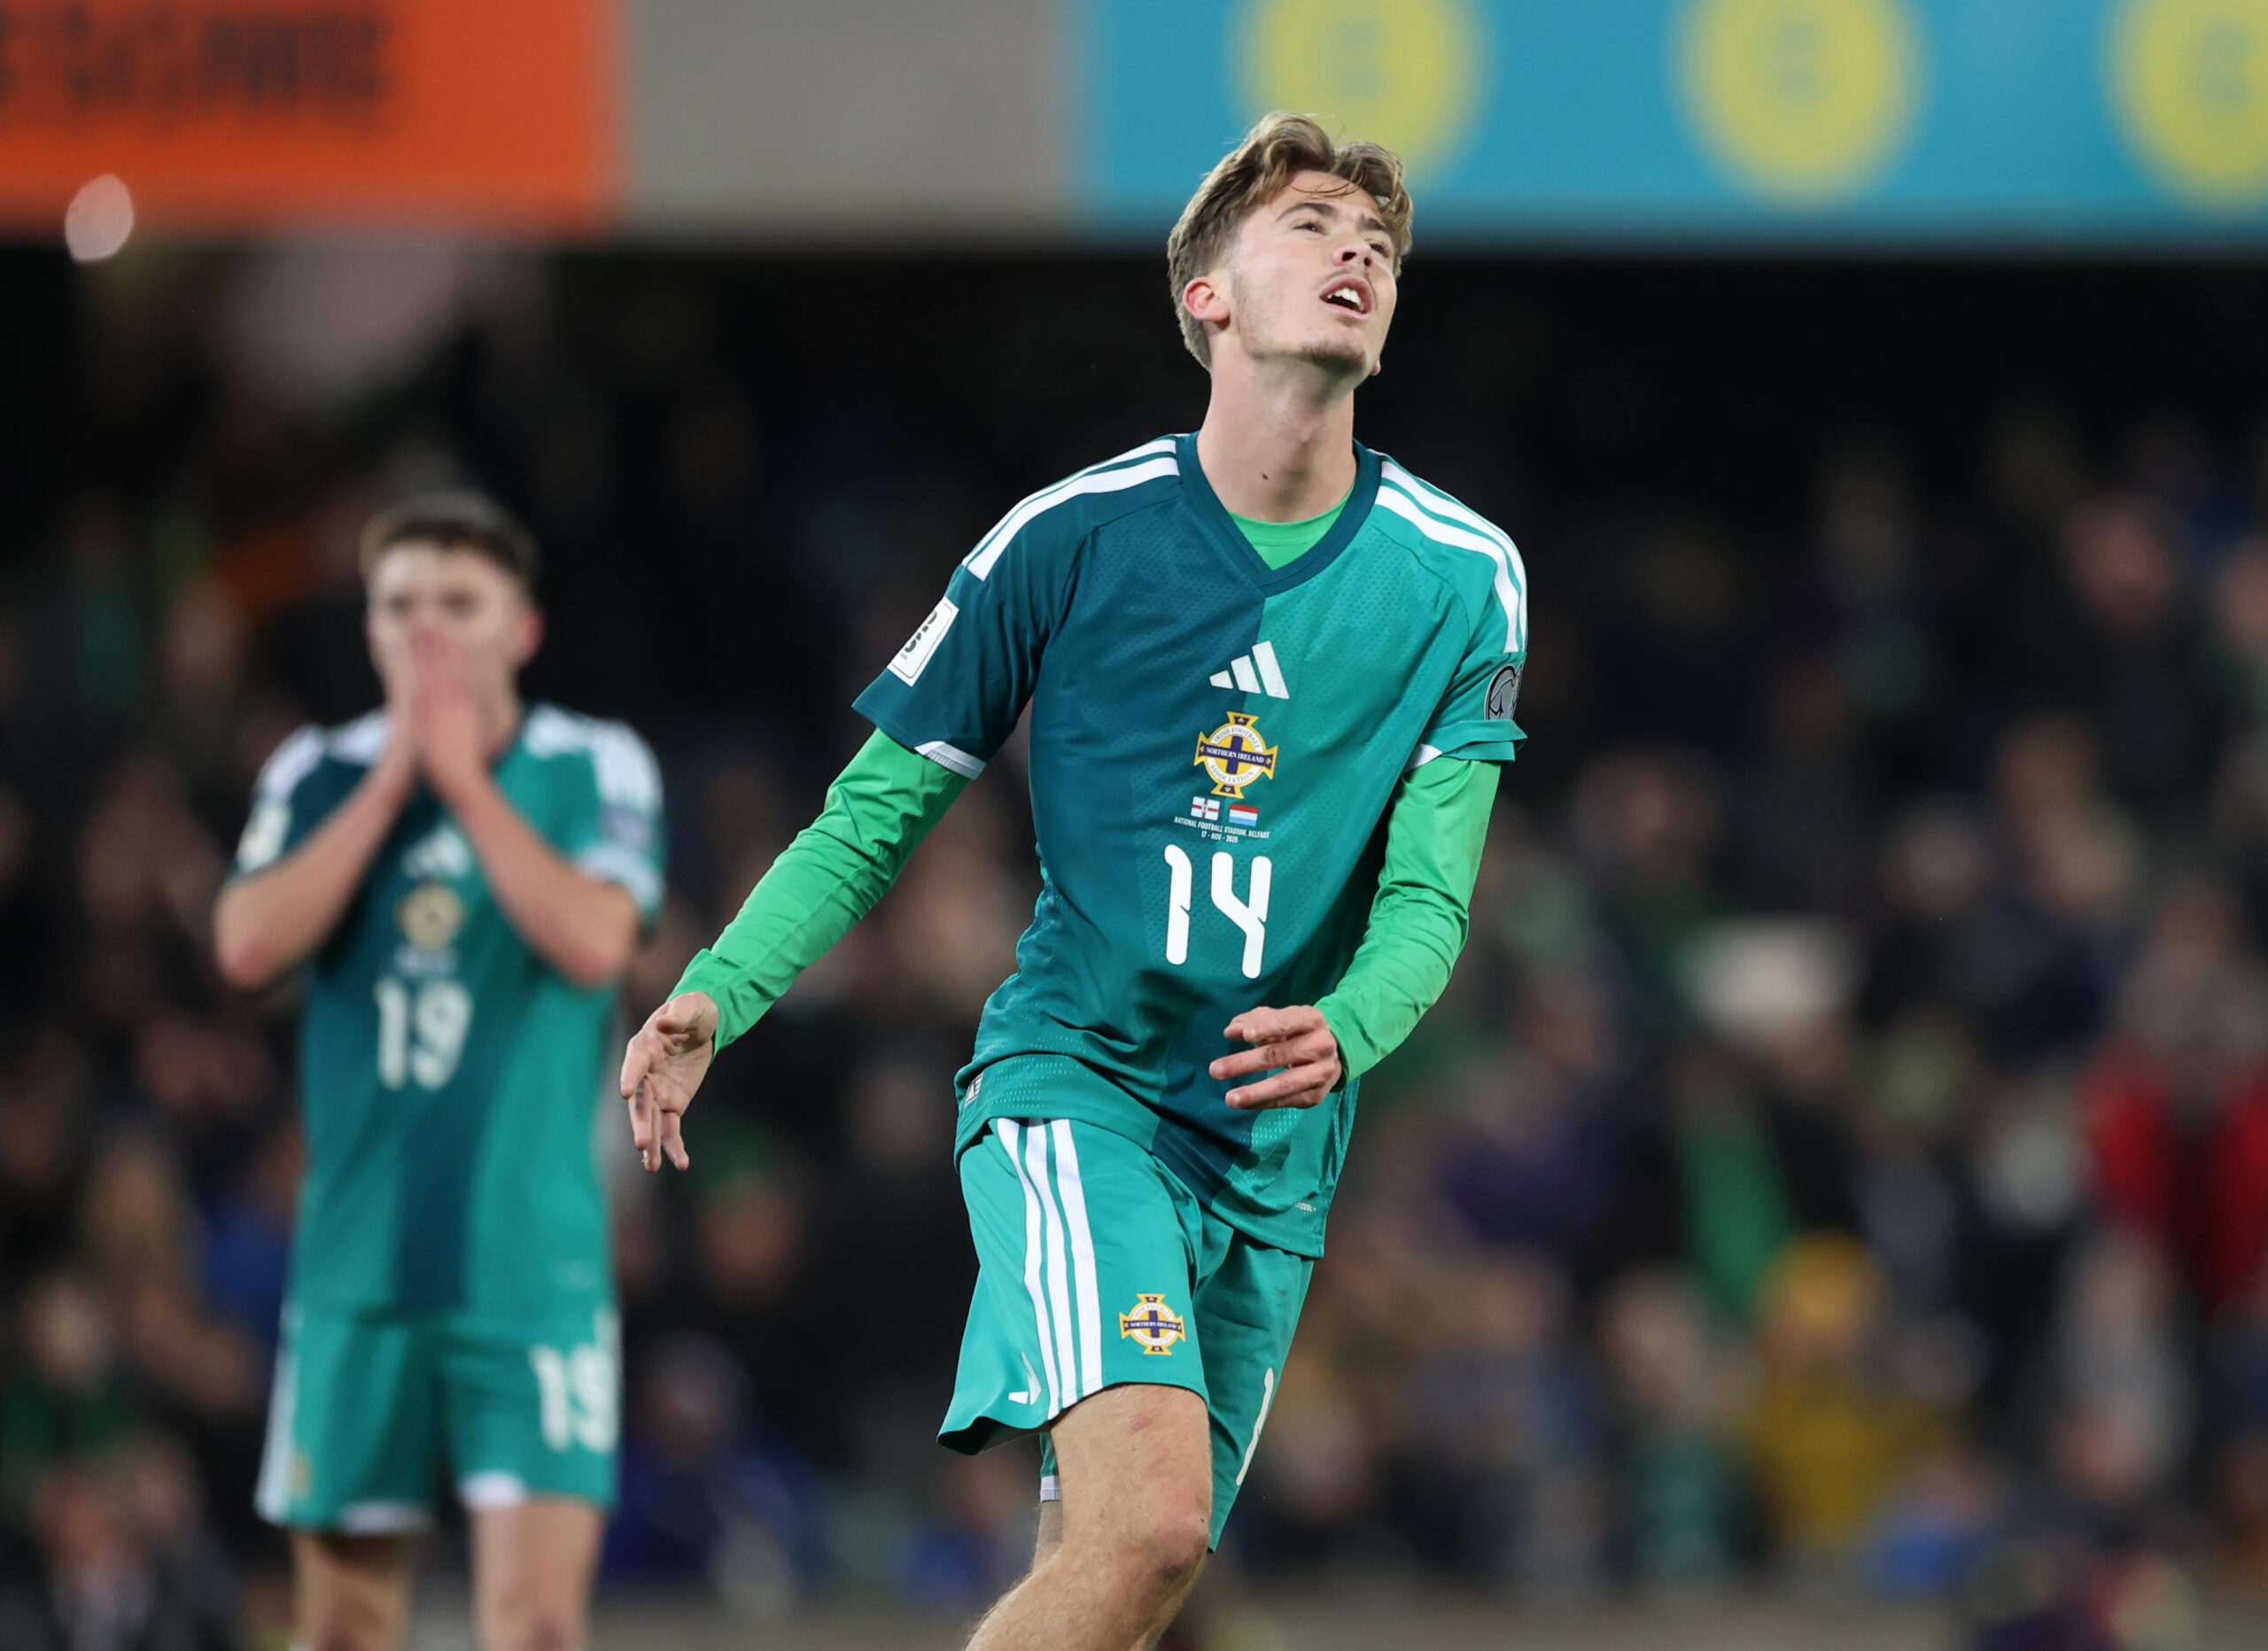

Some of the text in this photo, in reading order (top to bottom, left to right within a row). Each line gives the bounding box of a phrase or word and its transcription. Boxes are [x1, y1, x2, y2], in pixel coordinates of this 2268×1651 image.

[1206, 747, 1265, 763] NORTHERN IRELAND
[1211, 763, 1254, 783] ASSOCIATION
[1174, 816, 1197, 827] NATIONAL
[1197, 821, 1223, 833] FOOTBALL
[1247, 830, 1270, 839] BELFAST
[1225, 834, 1239, 843] 2025
[1164, 844, 1272, 979] 14
[373, 978, 474, 1090] 19
[531, 1344, 620, 1453] 19
